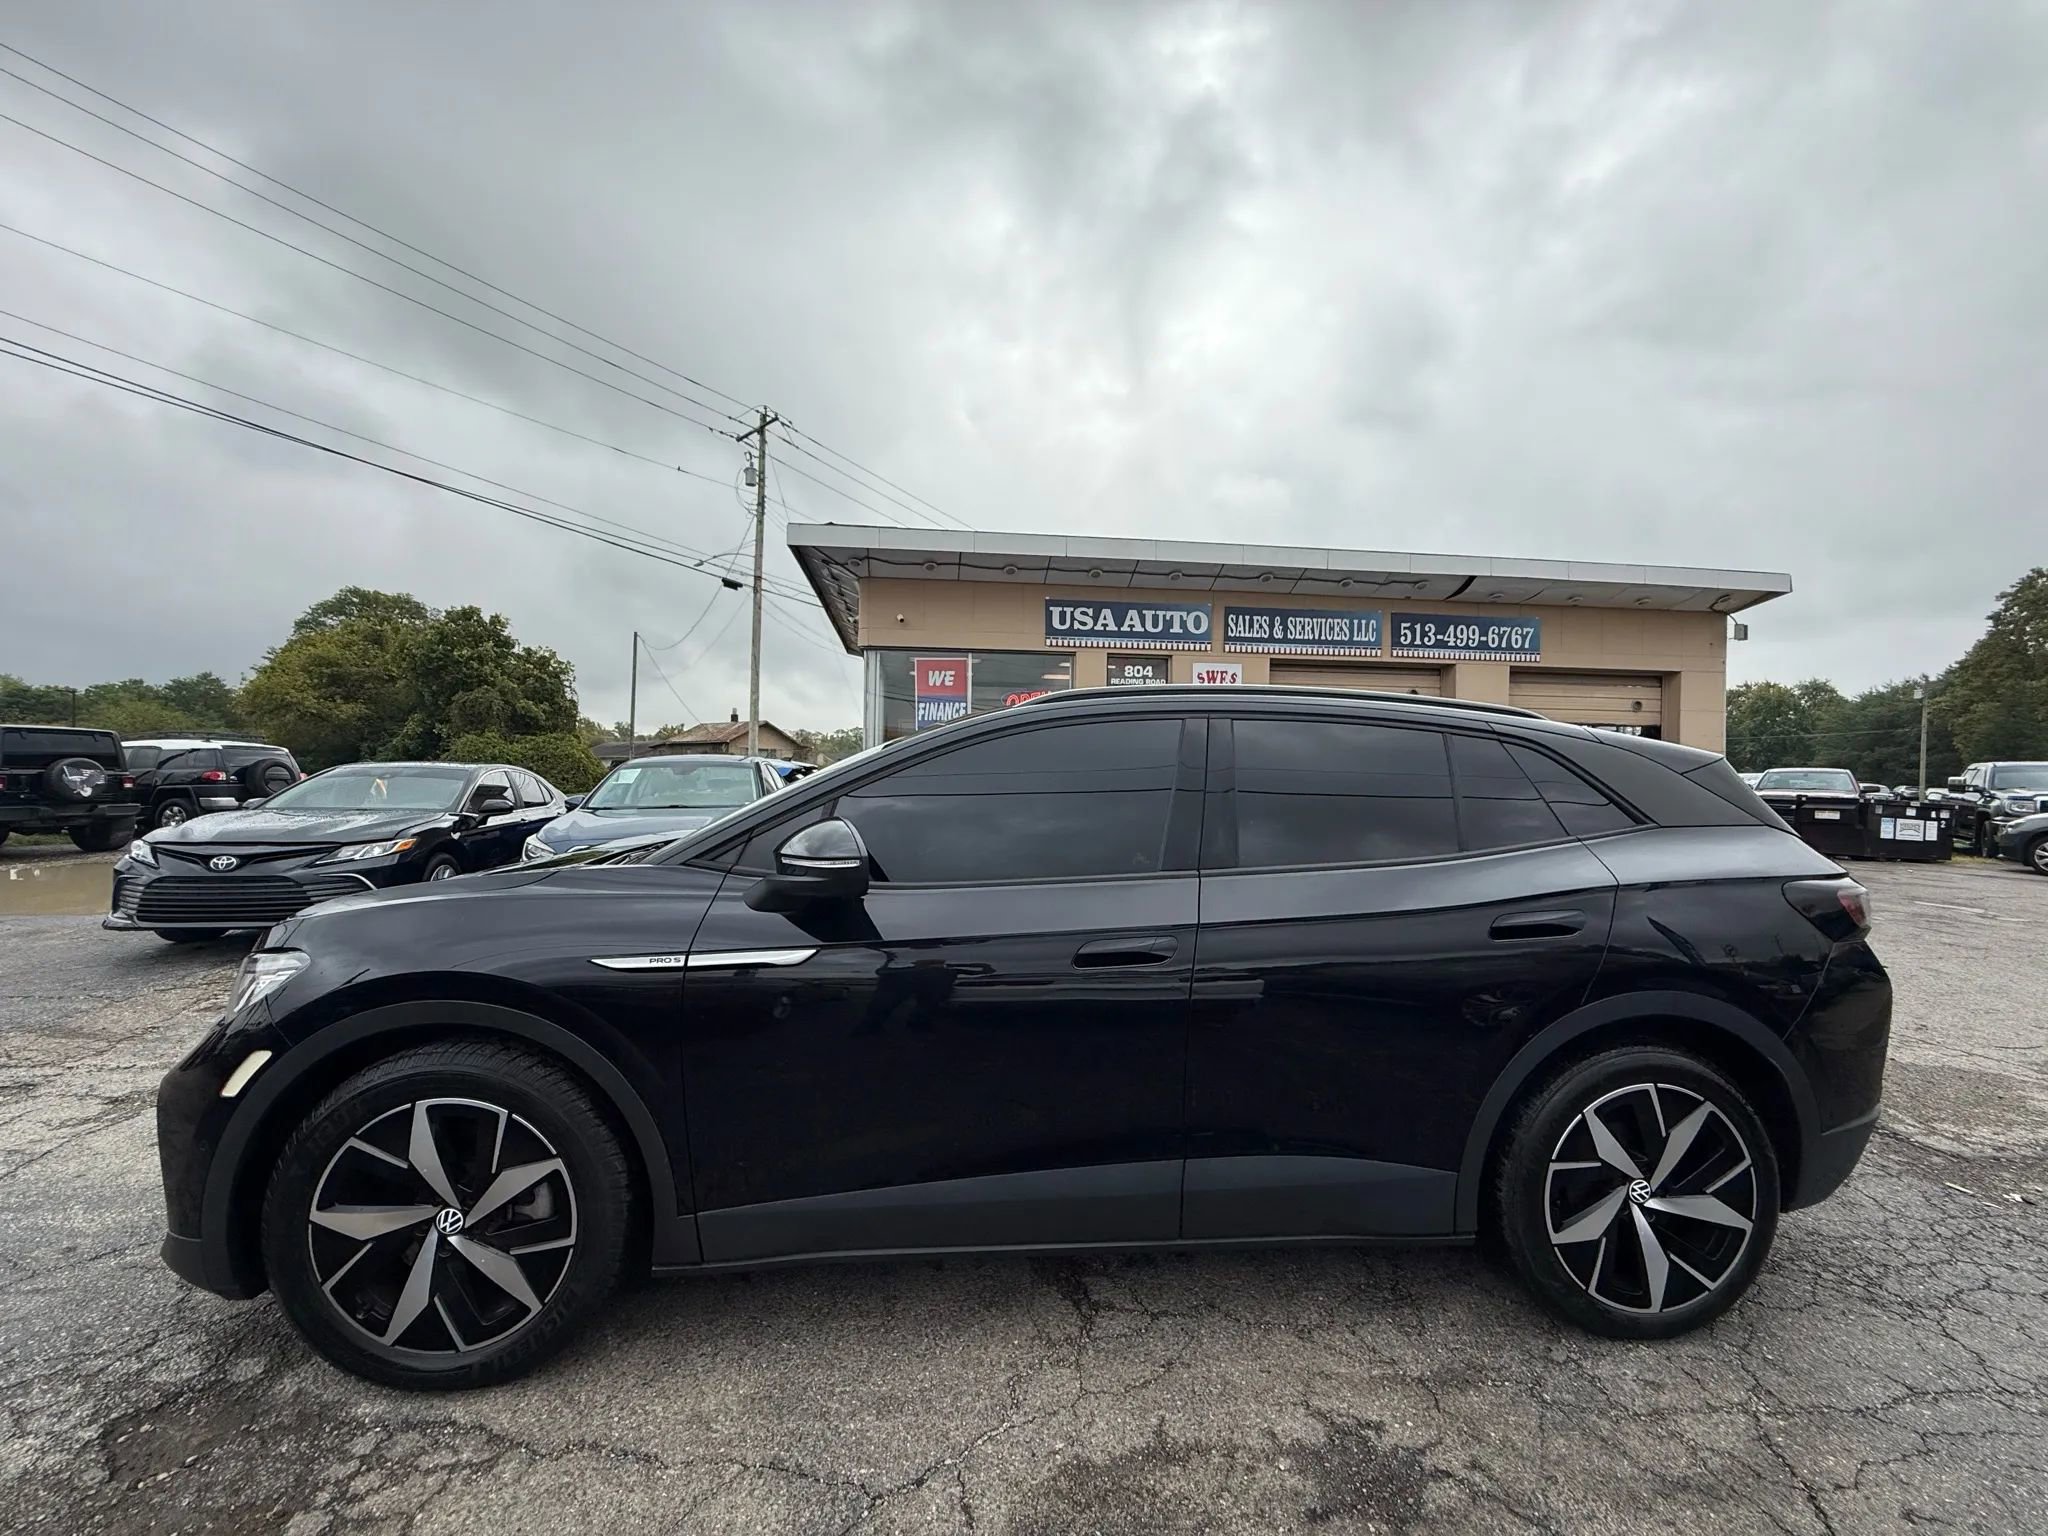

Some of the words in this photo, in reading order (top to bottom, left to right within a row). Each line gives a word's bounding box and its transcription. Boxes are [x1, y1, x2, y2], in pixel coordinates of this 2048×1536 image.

[1050, 606, 1118, 632] USA
[1119, 609, 1209, 635] AUTO
[1228, 614, 1270, 638] SALES
[1273, 617, 1285, 640] &
[1287, 617, 1350, 642] SERVICES
[1353, 620, 1377, 642] LLC
[1399, 622, 1535, 649] 513-499-6767
[928, 670, 956, 687] WE
[1124, 665, 1153, 678] 804
[1110, 677, 1144, 685] READING
[1145, 678, 1166, 686] ROAD
[918, 702, 967, 721] FINANCE
